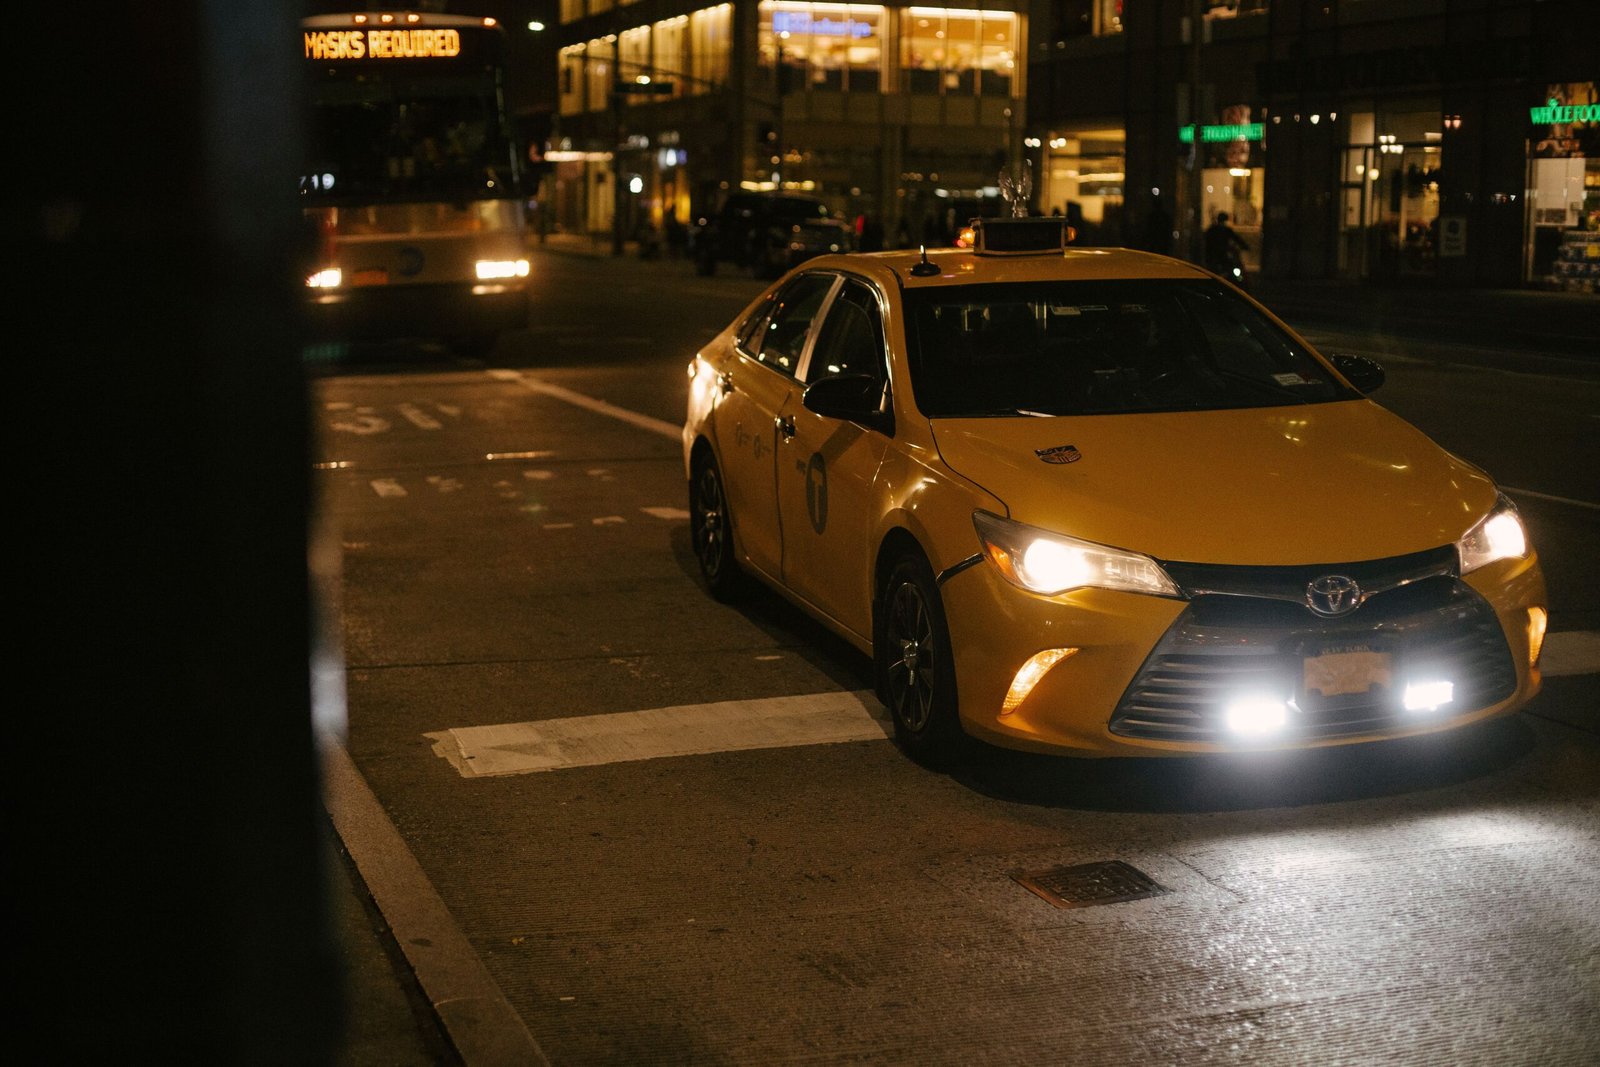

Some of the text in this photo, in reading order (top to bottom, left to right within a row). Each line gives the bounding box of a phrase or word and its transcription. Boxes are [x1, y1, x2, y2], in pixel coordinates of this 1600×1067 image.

[304, 29, 461, 59] MASKS REQUIRED
[1574, 104, 1600, 122] FOO
